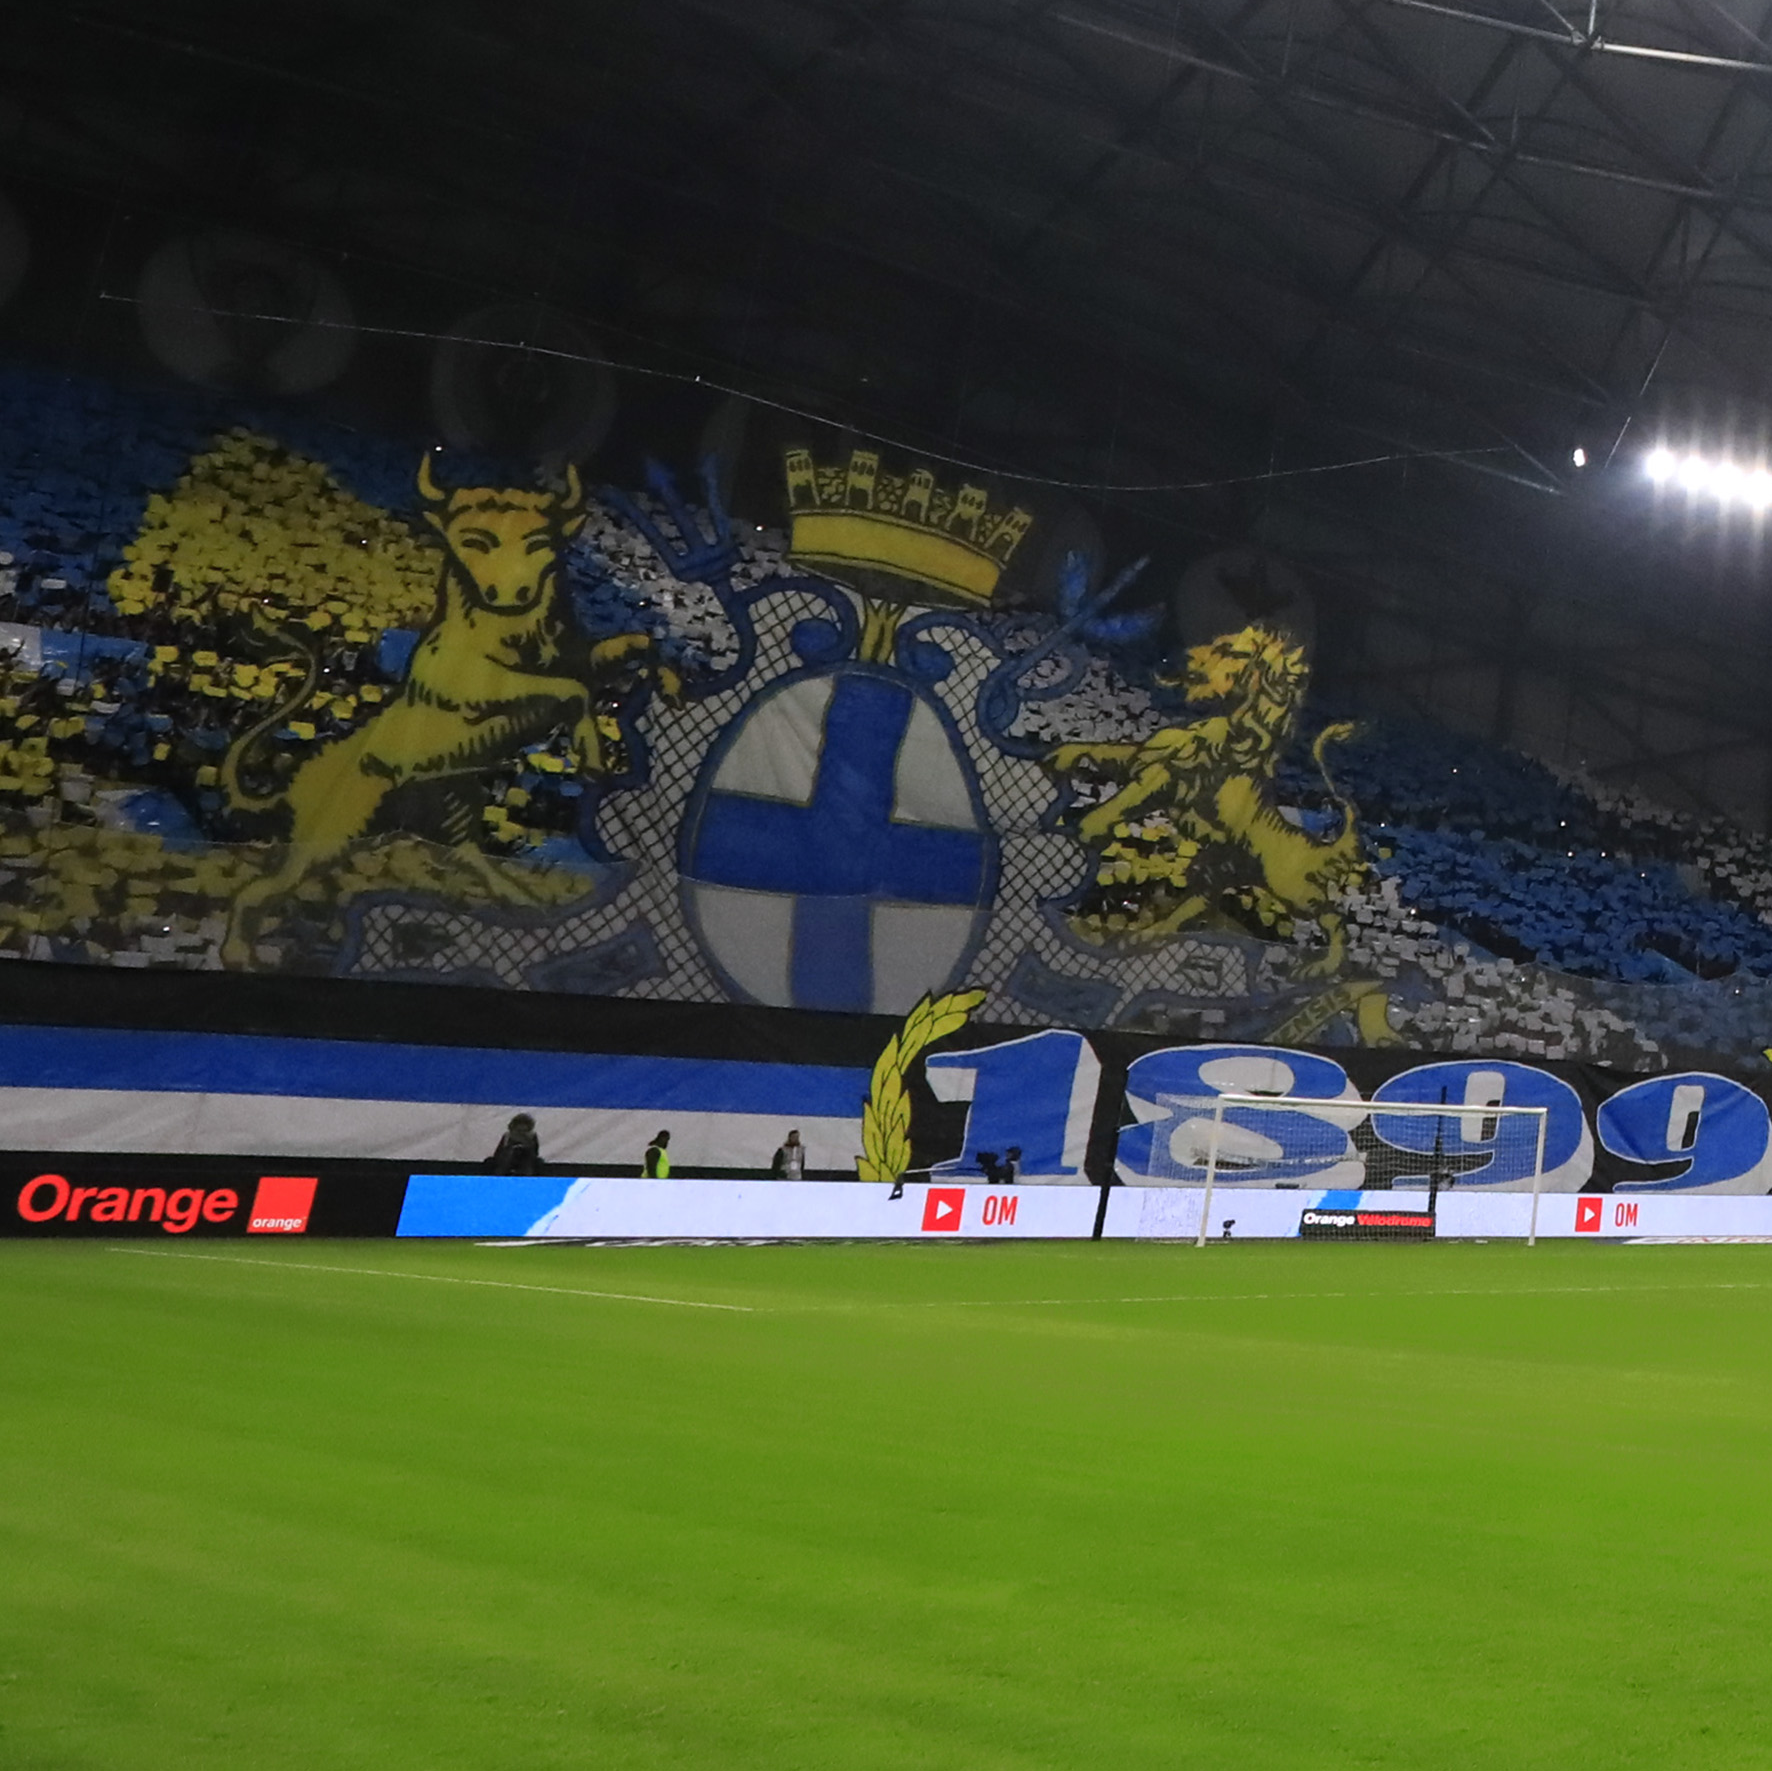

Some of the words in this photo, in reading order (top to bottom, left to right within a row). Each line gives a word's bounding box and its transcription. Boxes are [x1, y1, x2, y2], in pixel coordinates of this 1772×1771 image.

[17, 1173, 240, 1233] Orange
[252, 1218, 303, 1231] orange
[982, 1195, 1018, 1226] OM
[1614, 1201, 1639, 1228] OM
[1302, 1211, 1356, 1228] Orange
